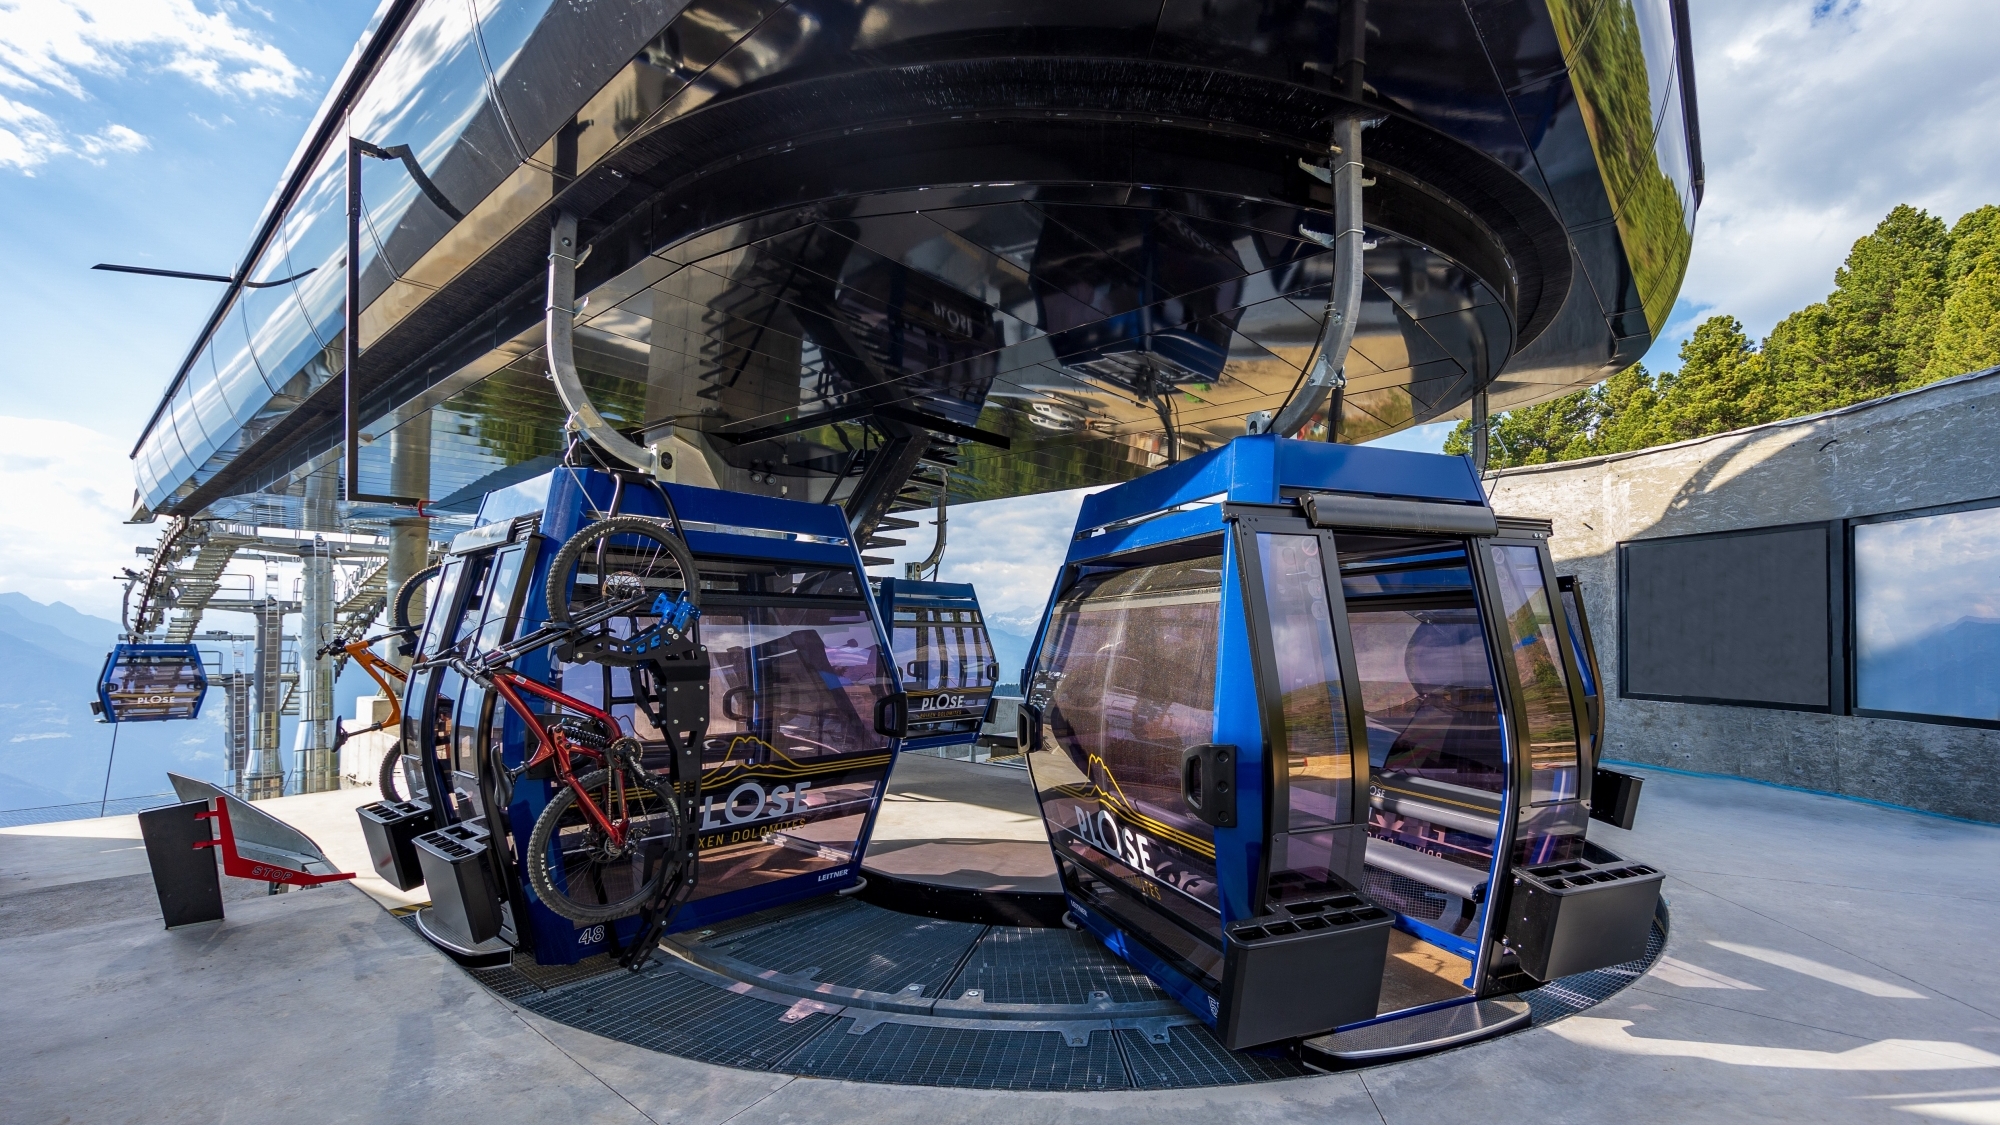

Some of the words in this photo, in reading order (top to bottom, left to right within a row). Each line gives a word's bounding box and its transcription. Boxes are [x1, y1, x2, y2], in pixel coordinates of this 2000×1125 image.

[580, 526, 616, 548] MAXXIS
[137, 695, 176, 704] PLOSE
[921, 693, 965, 711] PLOSE
[1369, 785, 1386, 798] OSE
[701, 781, 812, 829] LOSE
[699, 833, 724, 849] XEN
[731, 818, 807, 843] DOLOMITES
[1074, 805, 1156, 877] PLOSE
[252, 866, 293, 880] STOP
[540, 852, 554, 891] MAXXIS
[817, 868, 850, 882] LEITNER
[578, 925, 605, 945] 48
